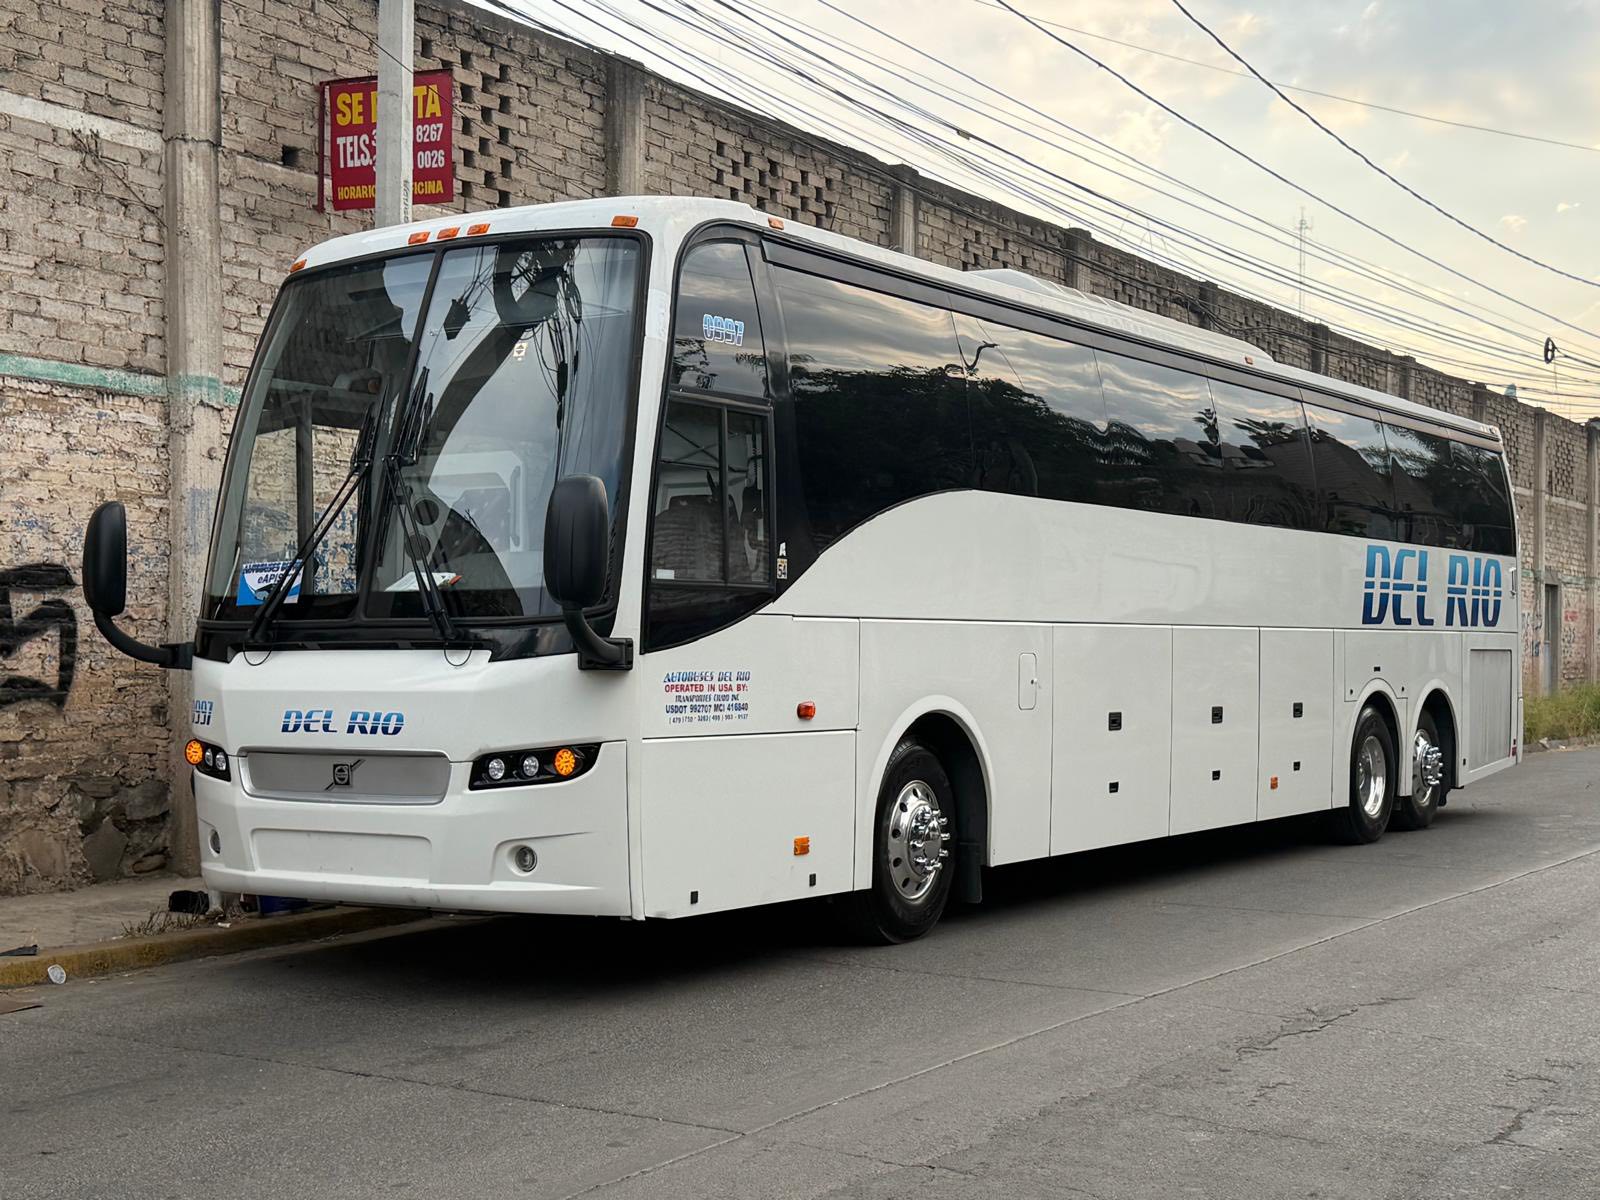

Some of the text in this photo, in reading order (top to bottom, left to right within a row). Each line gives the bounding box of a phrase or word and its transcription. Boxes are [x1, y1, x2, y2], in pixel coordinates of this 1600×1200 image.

[336, 92, 363, 126] SE
[416, 123, 443, 142] 8267
[336, 134, 373, 168] TELS.
[417, 150, 445, 168] 0026
[412, 180, 444, 195] ICINA
[703, 314, 744, 347] 0997
[1362, 545, 1502, 627] DEL RIO
[663, 671, 751, 683] AUTOBUSES DEL RIO
[664, 683, 749, 693] OPERATED IN USA BY:
[665, 705, 687, 713] USDOT
[281, 710, 404, 735] DEL RIO
